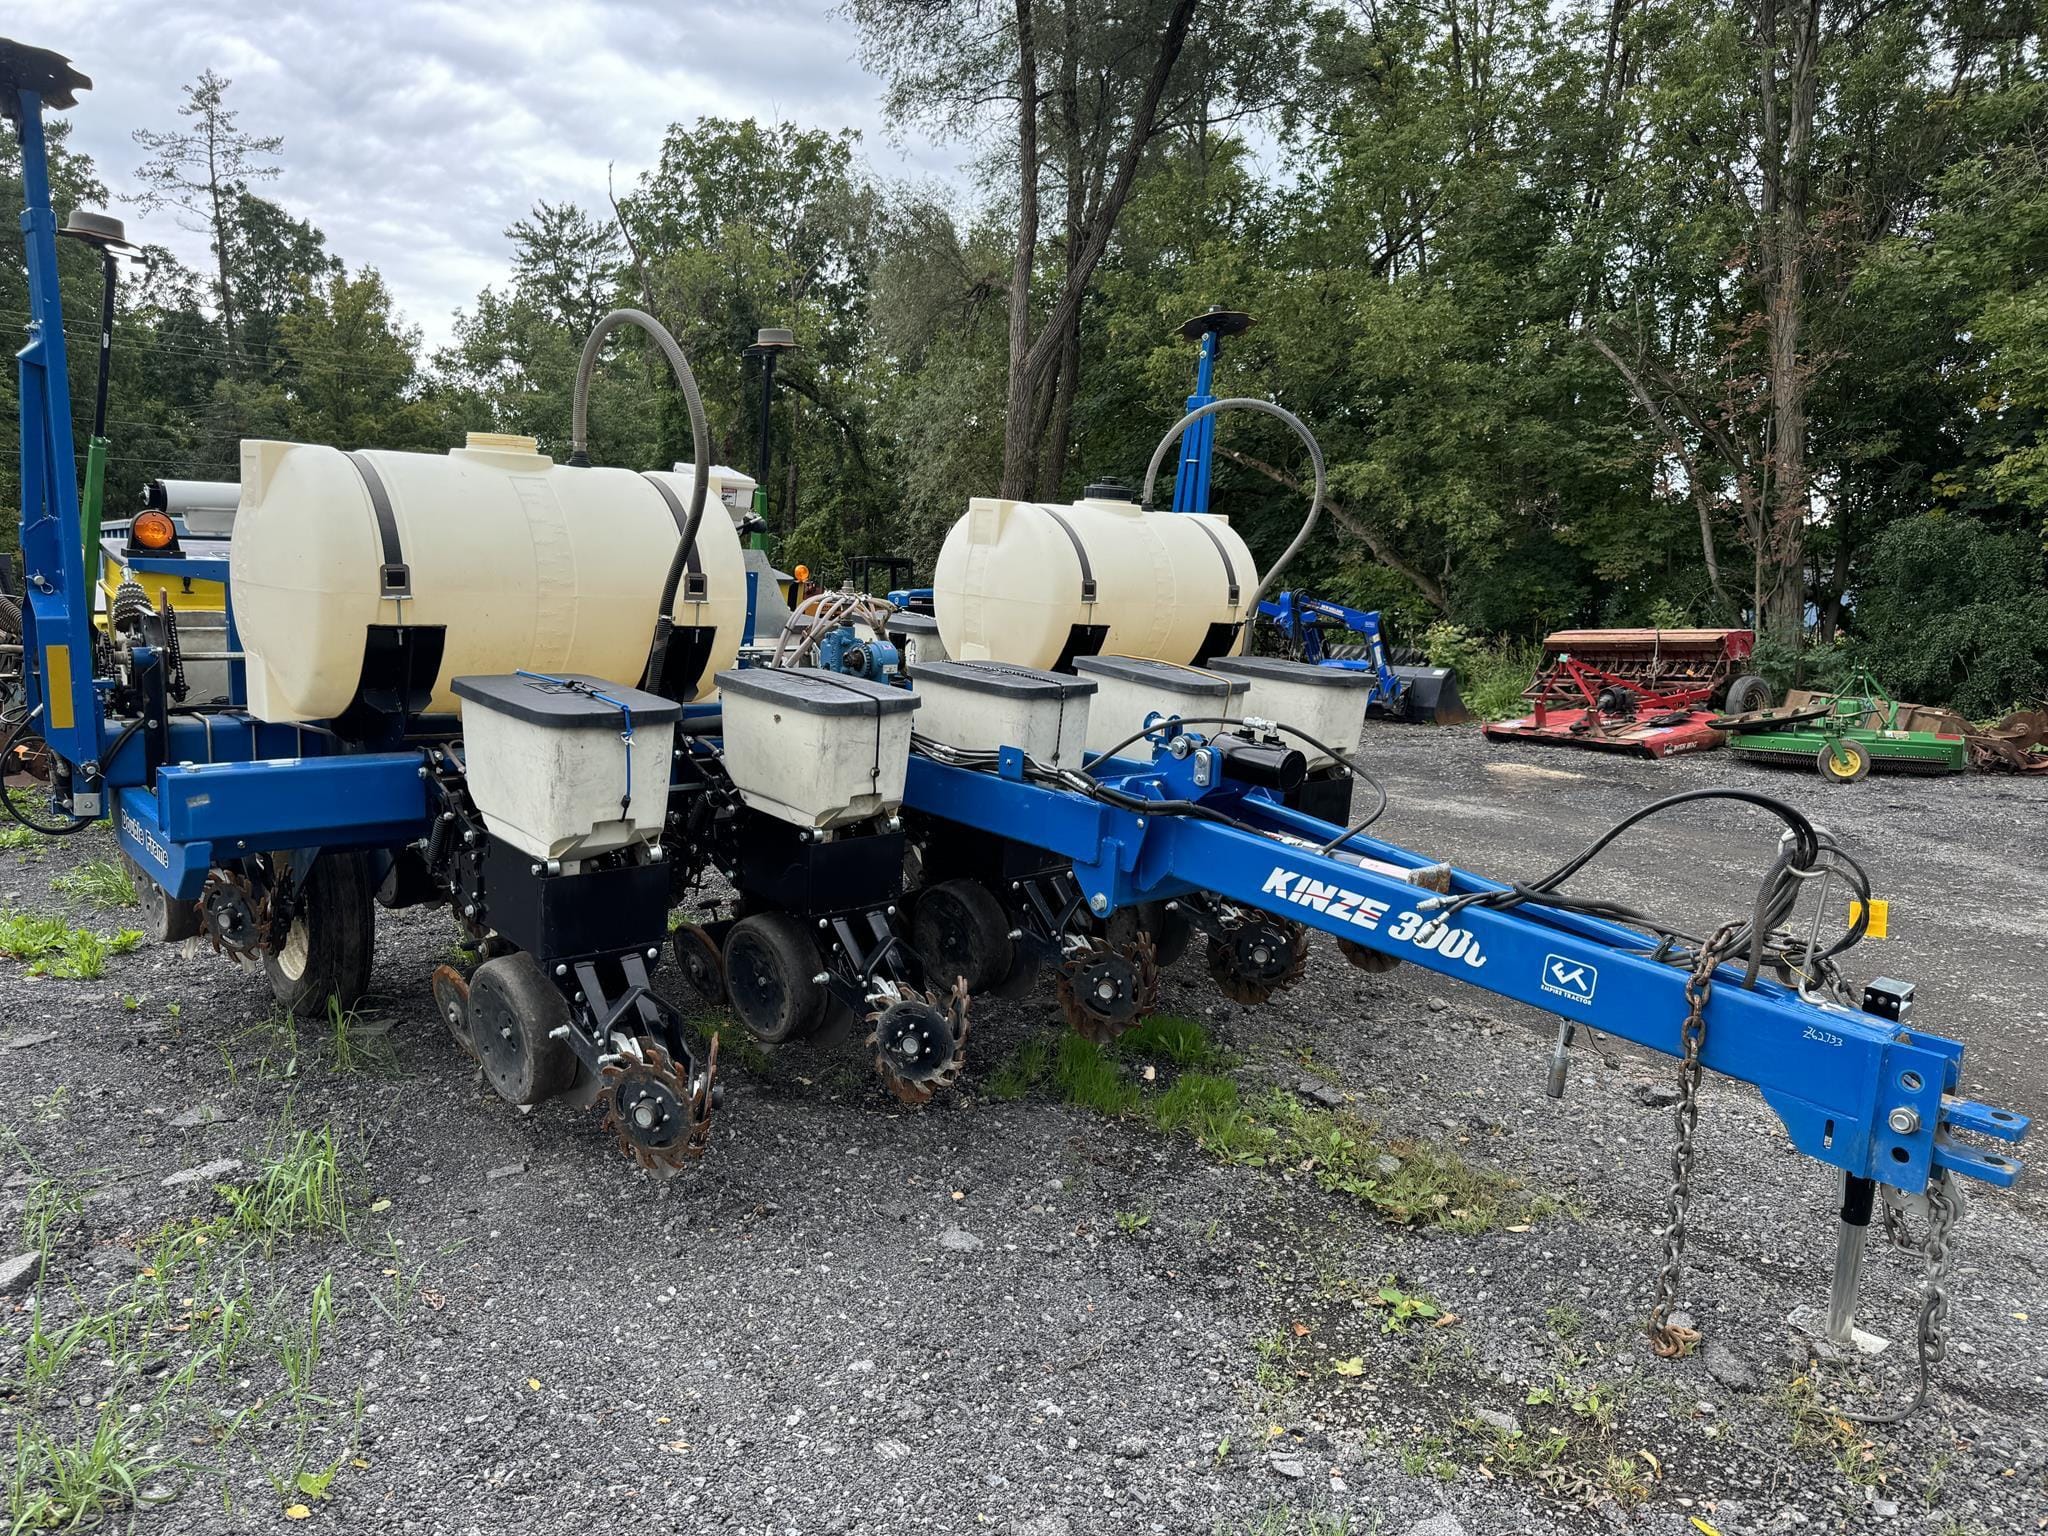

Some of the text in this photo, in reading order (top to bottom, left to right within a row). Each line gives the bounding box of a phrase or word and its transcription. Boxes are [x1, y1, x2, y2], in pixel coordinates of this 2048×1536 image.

[121, 808, 169, 869] Double Frame
[1261, 866, 1391, 931] KINZE
[1540, 984, 1593, 1006] EMPIRE TRACTOR
